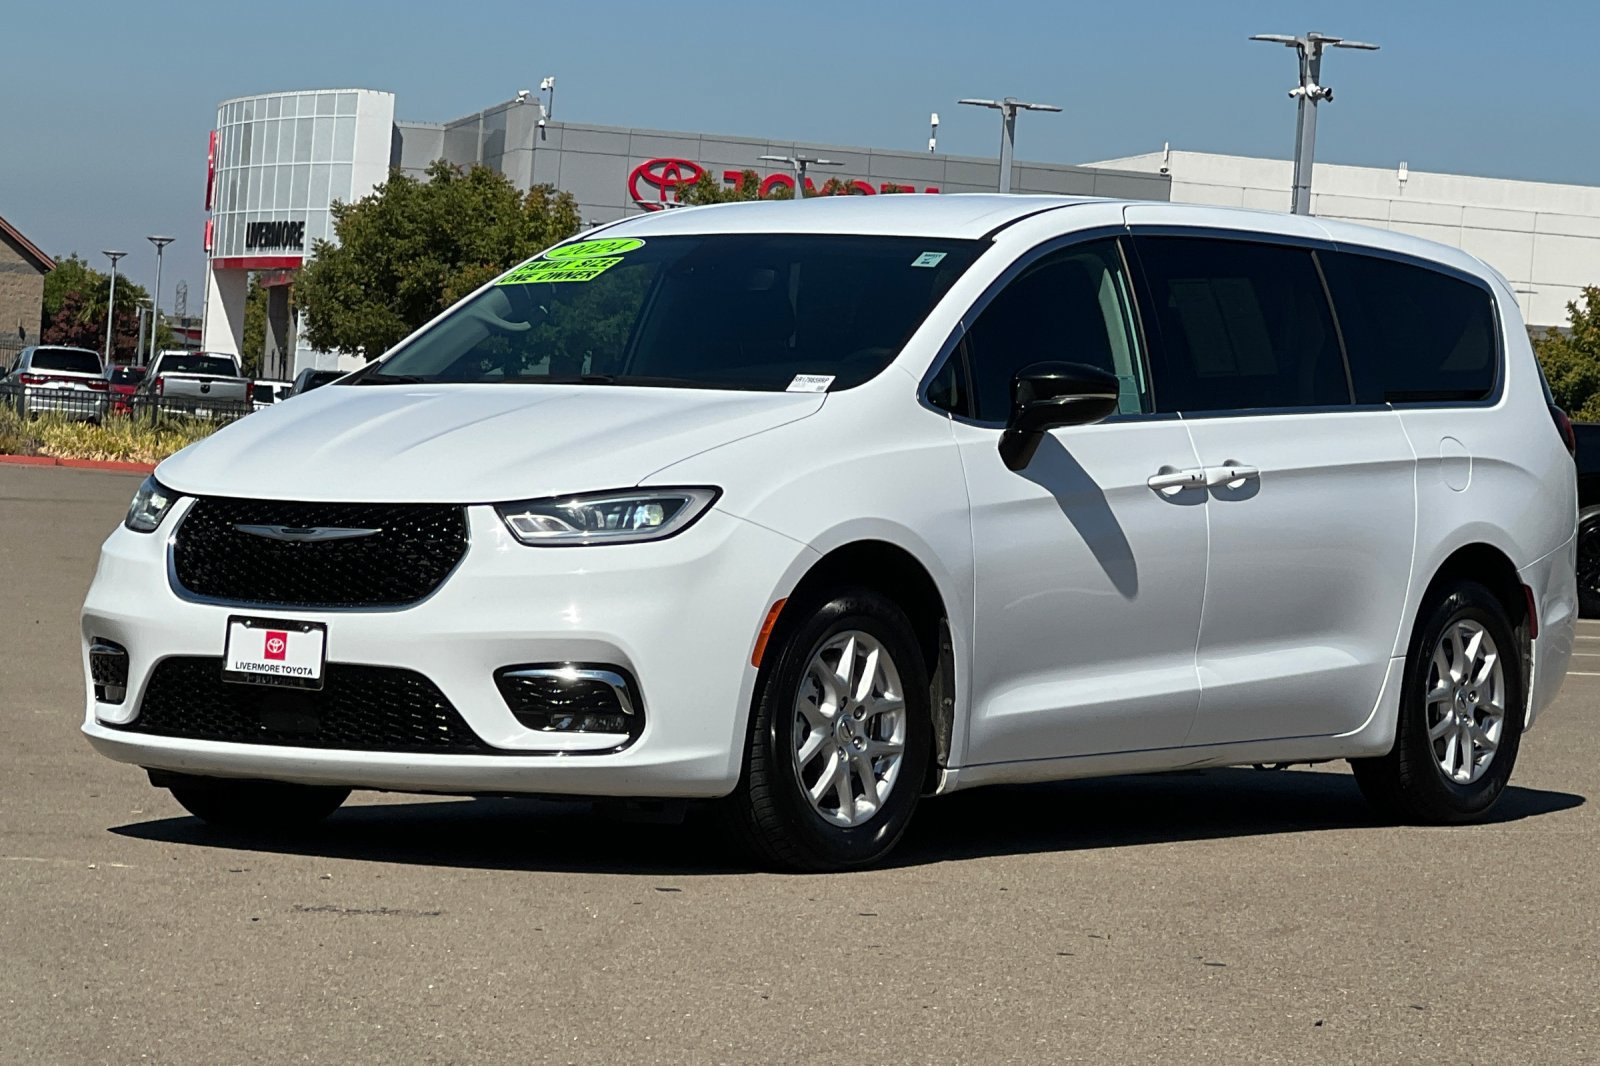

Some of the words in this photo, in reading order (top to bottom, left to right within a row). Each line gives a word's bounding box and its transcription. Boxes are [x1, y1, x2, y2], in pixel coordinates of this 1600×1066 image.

[724, 170, 940, 197] TOY
[246, 221, 305, 249] LIVERMORE
[556, 241, 633, 256] 2024
[517, 260, 575, 272] FAMILY
[575, 258, 619, 269] SIZE
[500, 272, 538, 284] ONE
[536, 270, 600, 281] OWNER
[235, 661, 280, 673] LIVERMORE
[281, 665, 313, 676] TOYOTA
